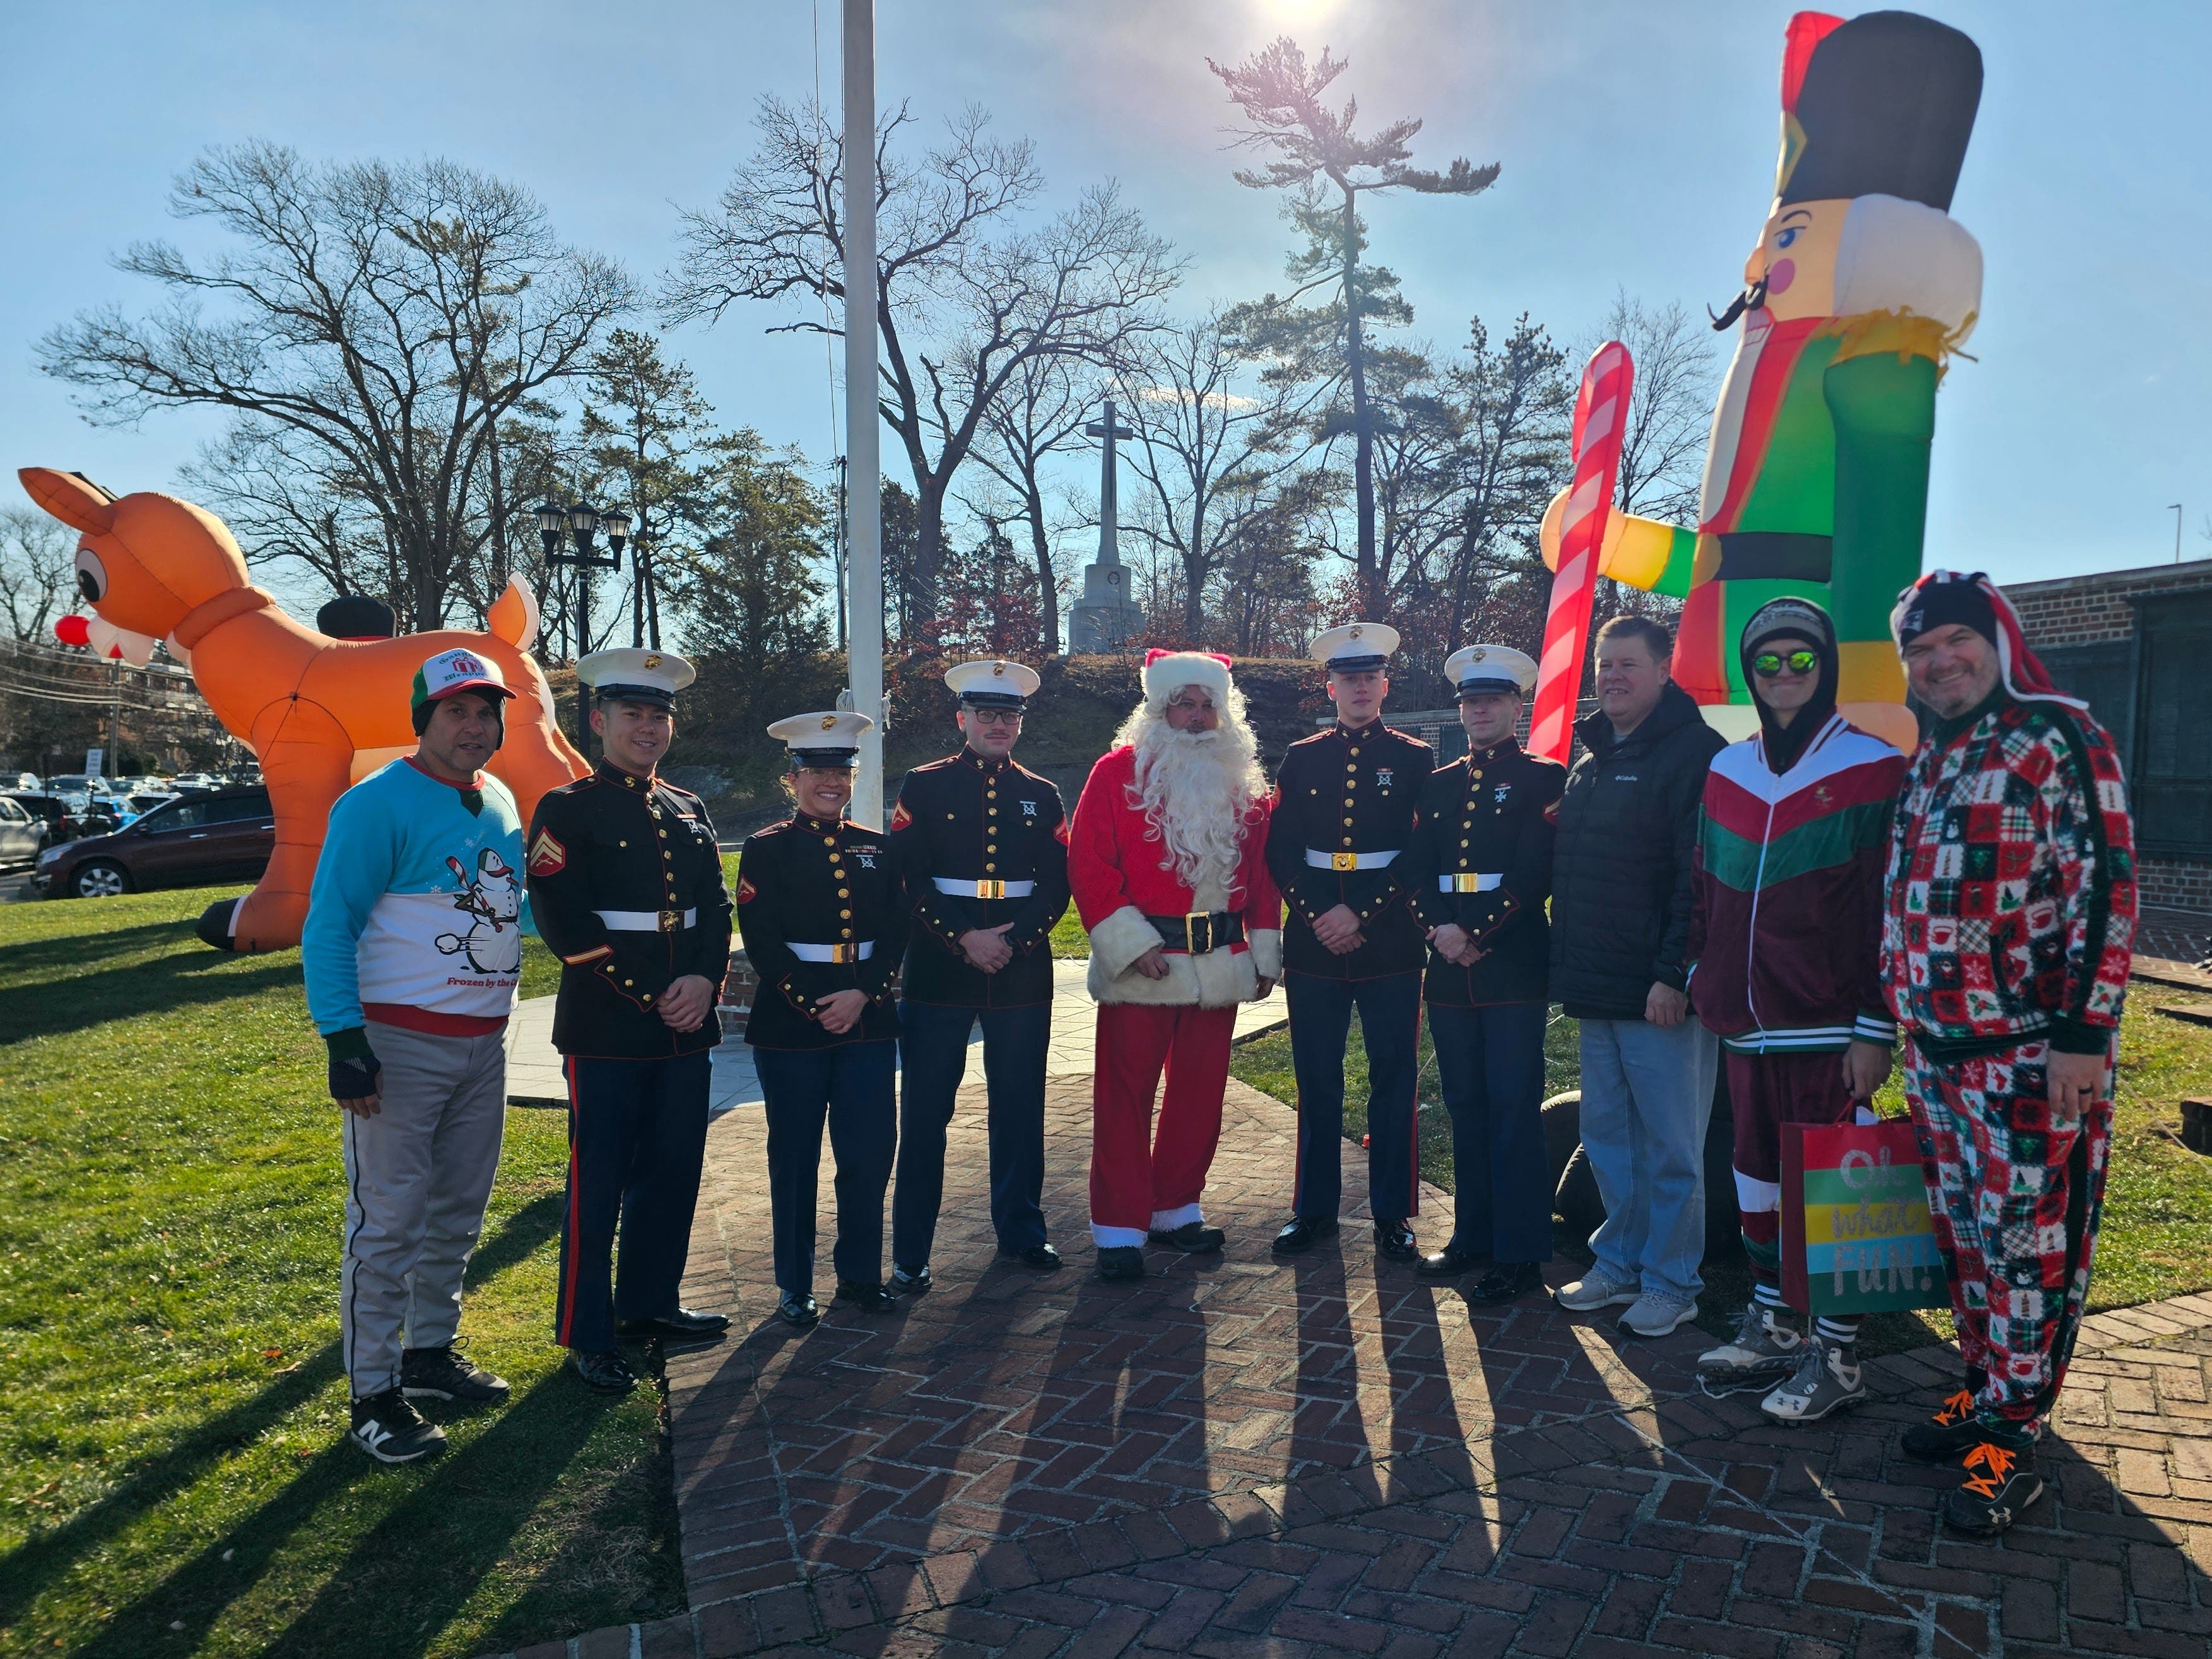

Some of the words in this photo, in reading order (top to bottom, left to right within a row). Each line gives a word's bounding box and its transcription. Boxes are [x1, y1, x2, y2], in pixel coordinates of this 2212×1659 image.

[447, 977, 485, 987] Frozen
[486, 978, 496, 988] by
[497, 978, 510, 987] the
[1840, 1146, 1907, 1189] Oh
[1832, 1193, 1921, 1238] what
